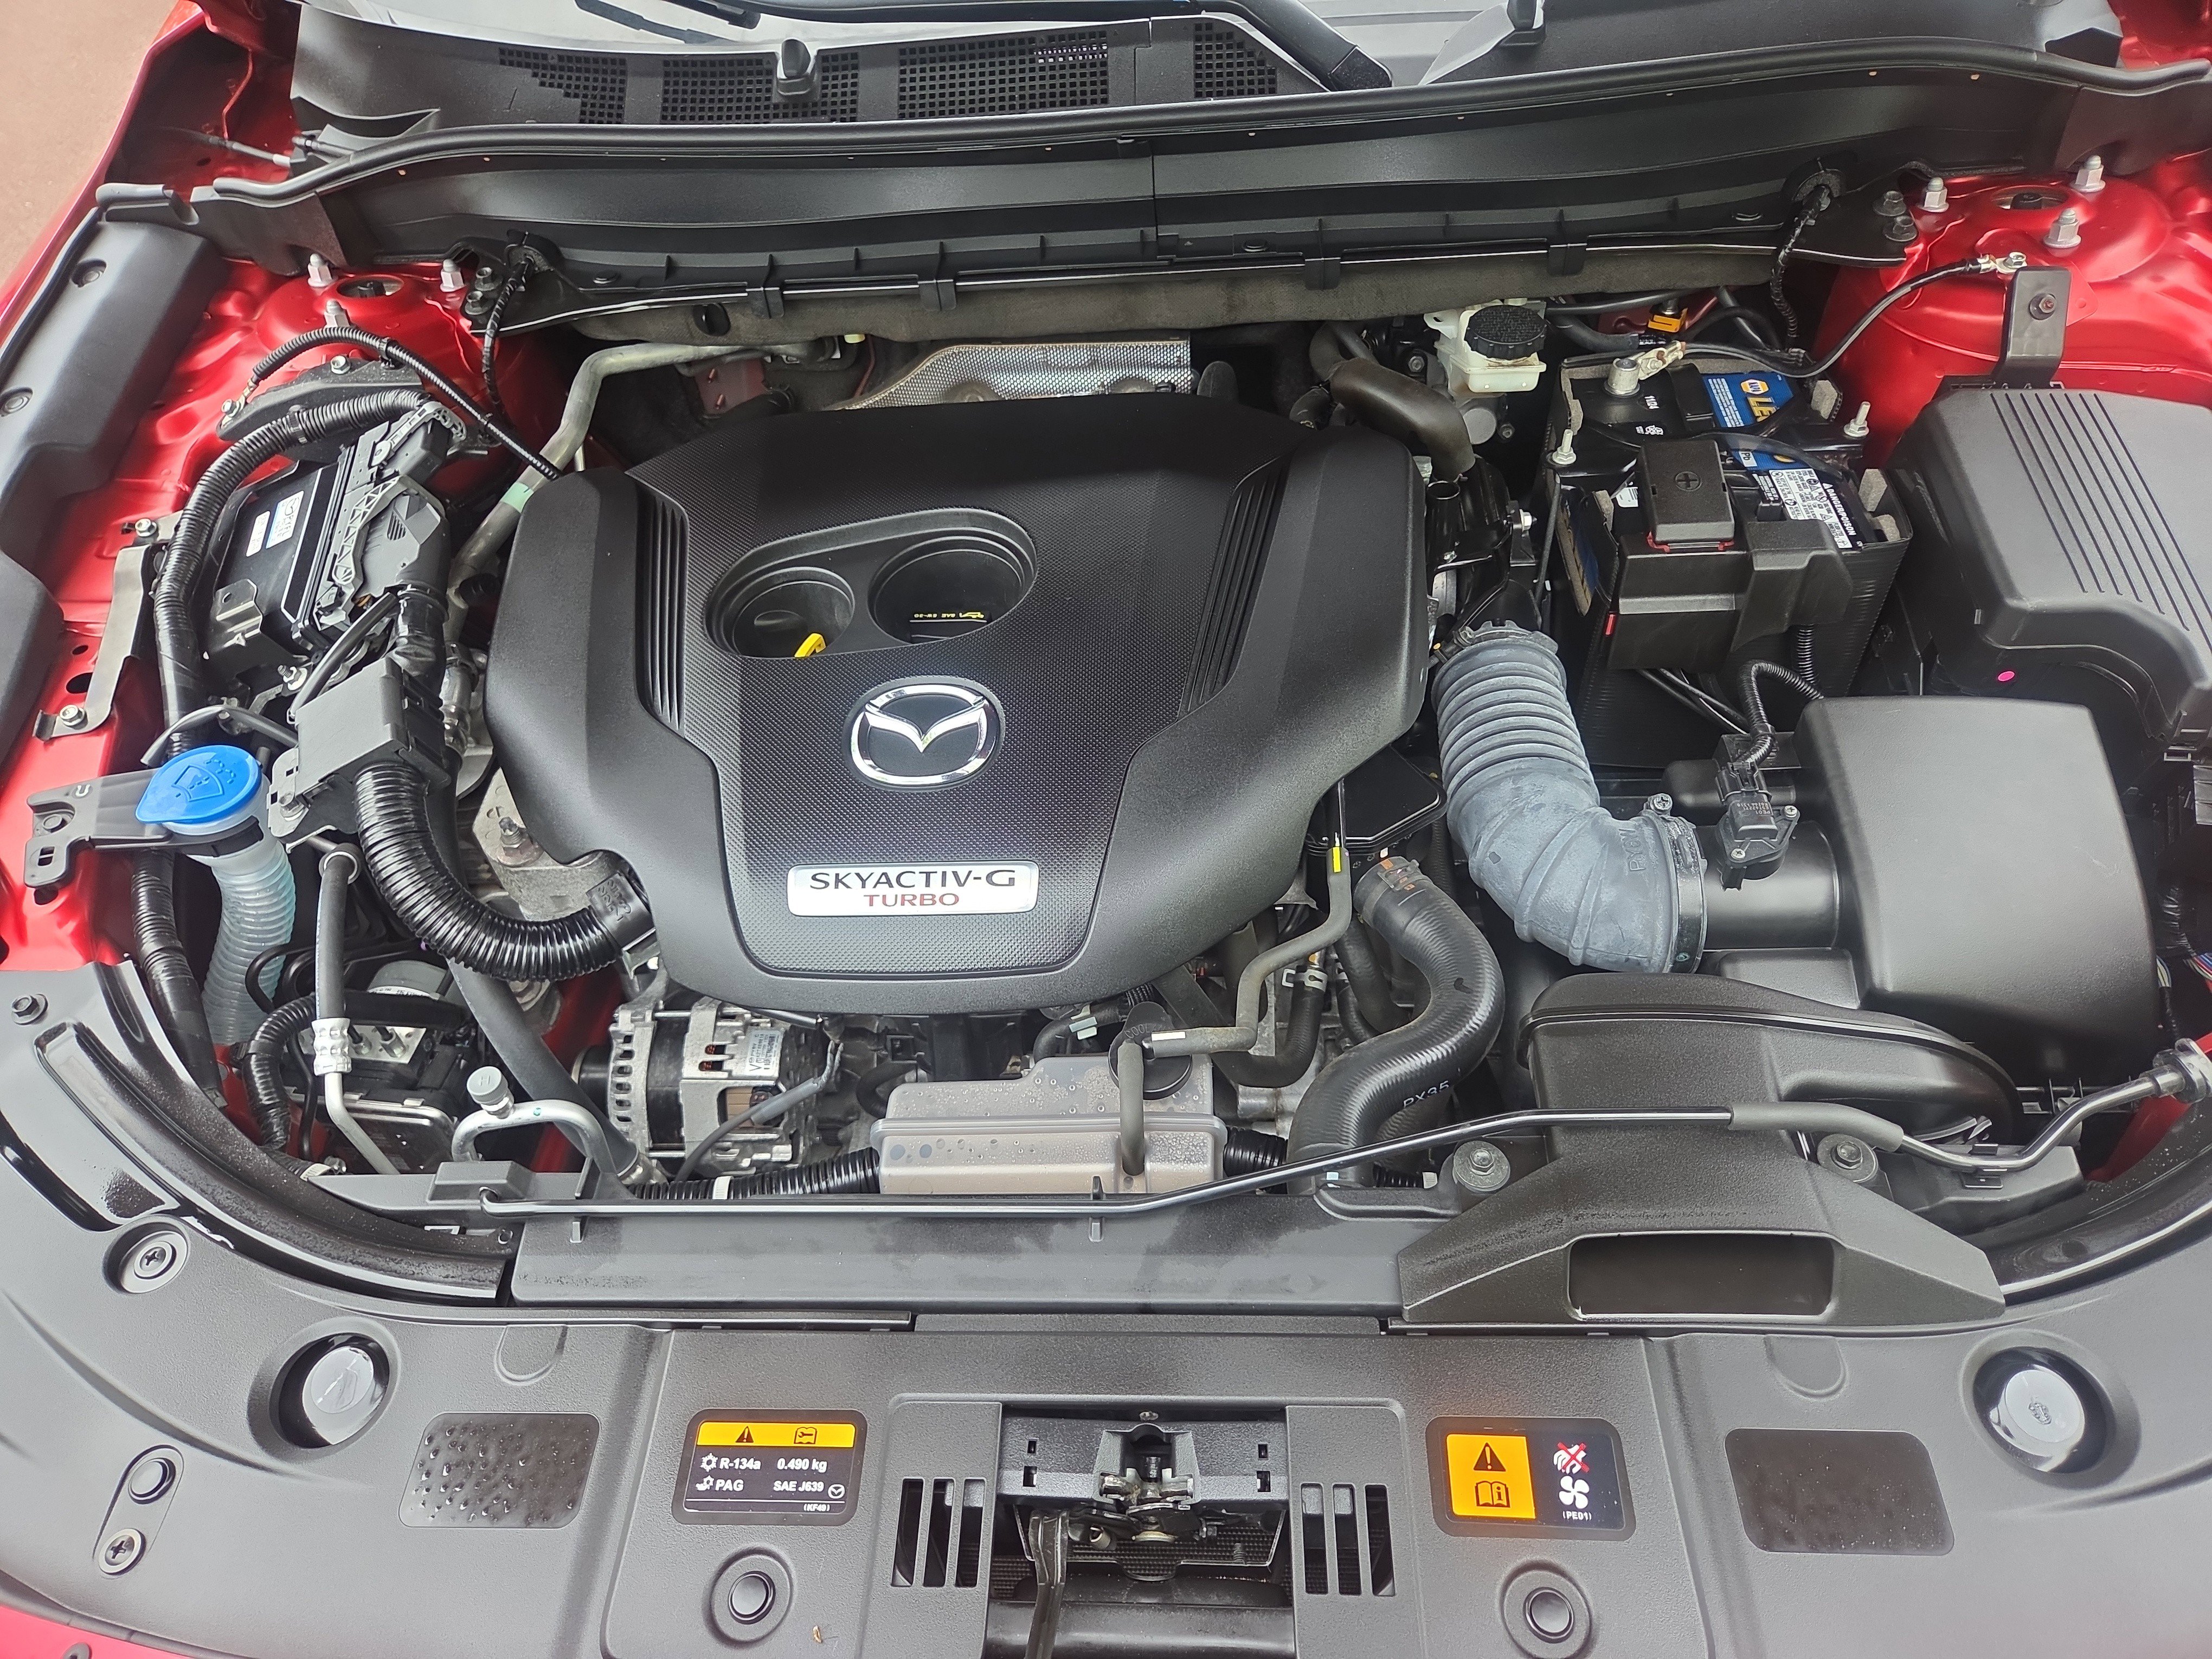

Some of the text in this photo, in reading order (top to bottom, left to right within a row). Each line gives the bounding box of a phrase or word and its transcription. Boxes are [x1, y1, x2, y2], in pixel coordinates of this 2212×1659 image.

[1644, 395, 1660, 409] 11/24
[1741, 453, 1752, 461] Pb
[1826, 488, 1857, 536] DANGER/POISON
[809, 869, 1016, 890] SKYACTIV-G
[863, 893, 960, 907] TURBO
[719, 1458, 827, 1473] R-134a 0.490 kg
[715, 1480, 824, 1493] PAG SAE J639
[803, 1503, 830, 1512] (KF49)
[1562, 1510, 1592, 1521] (PE01)
